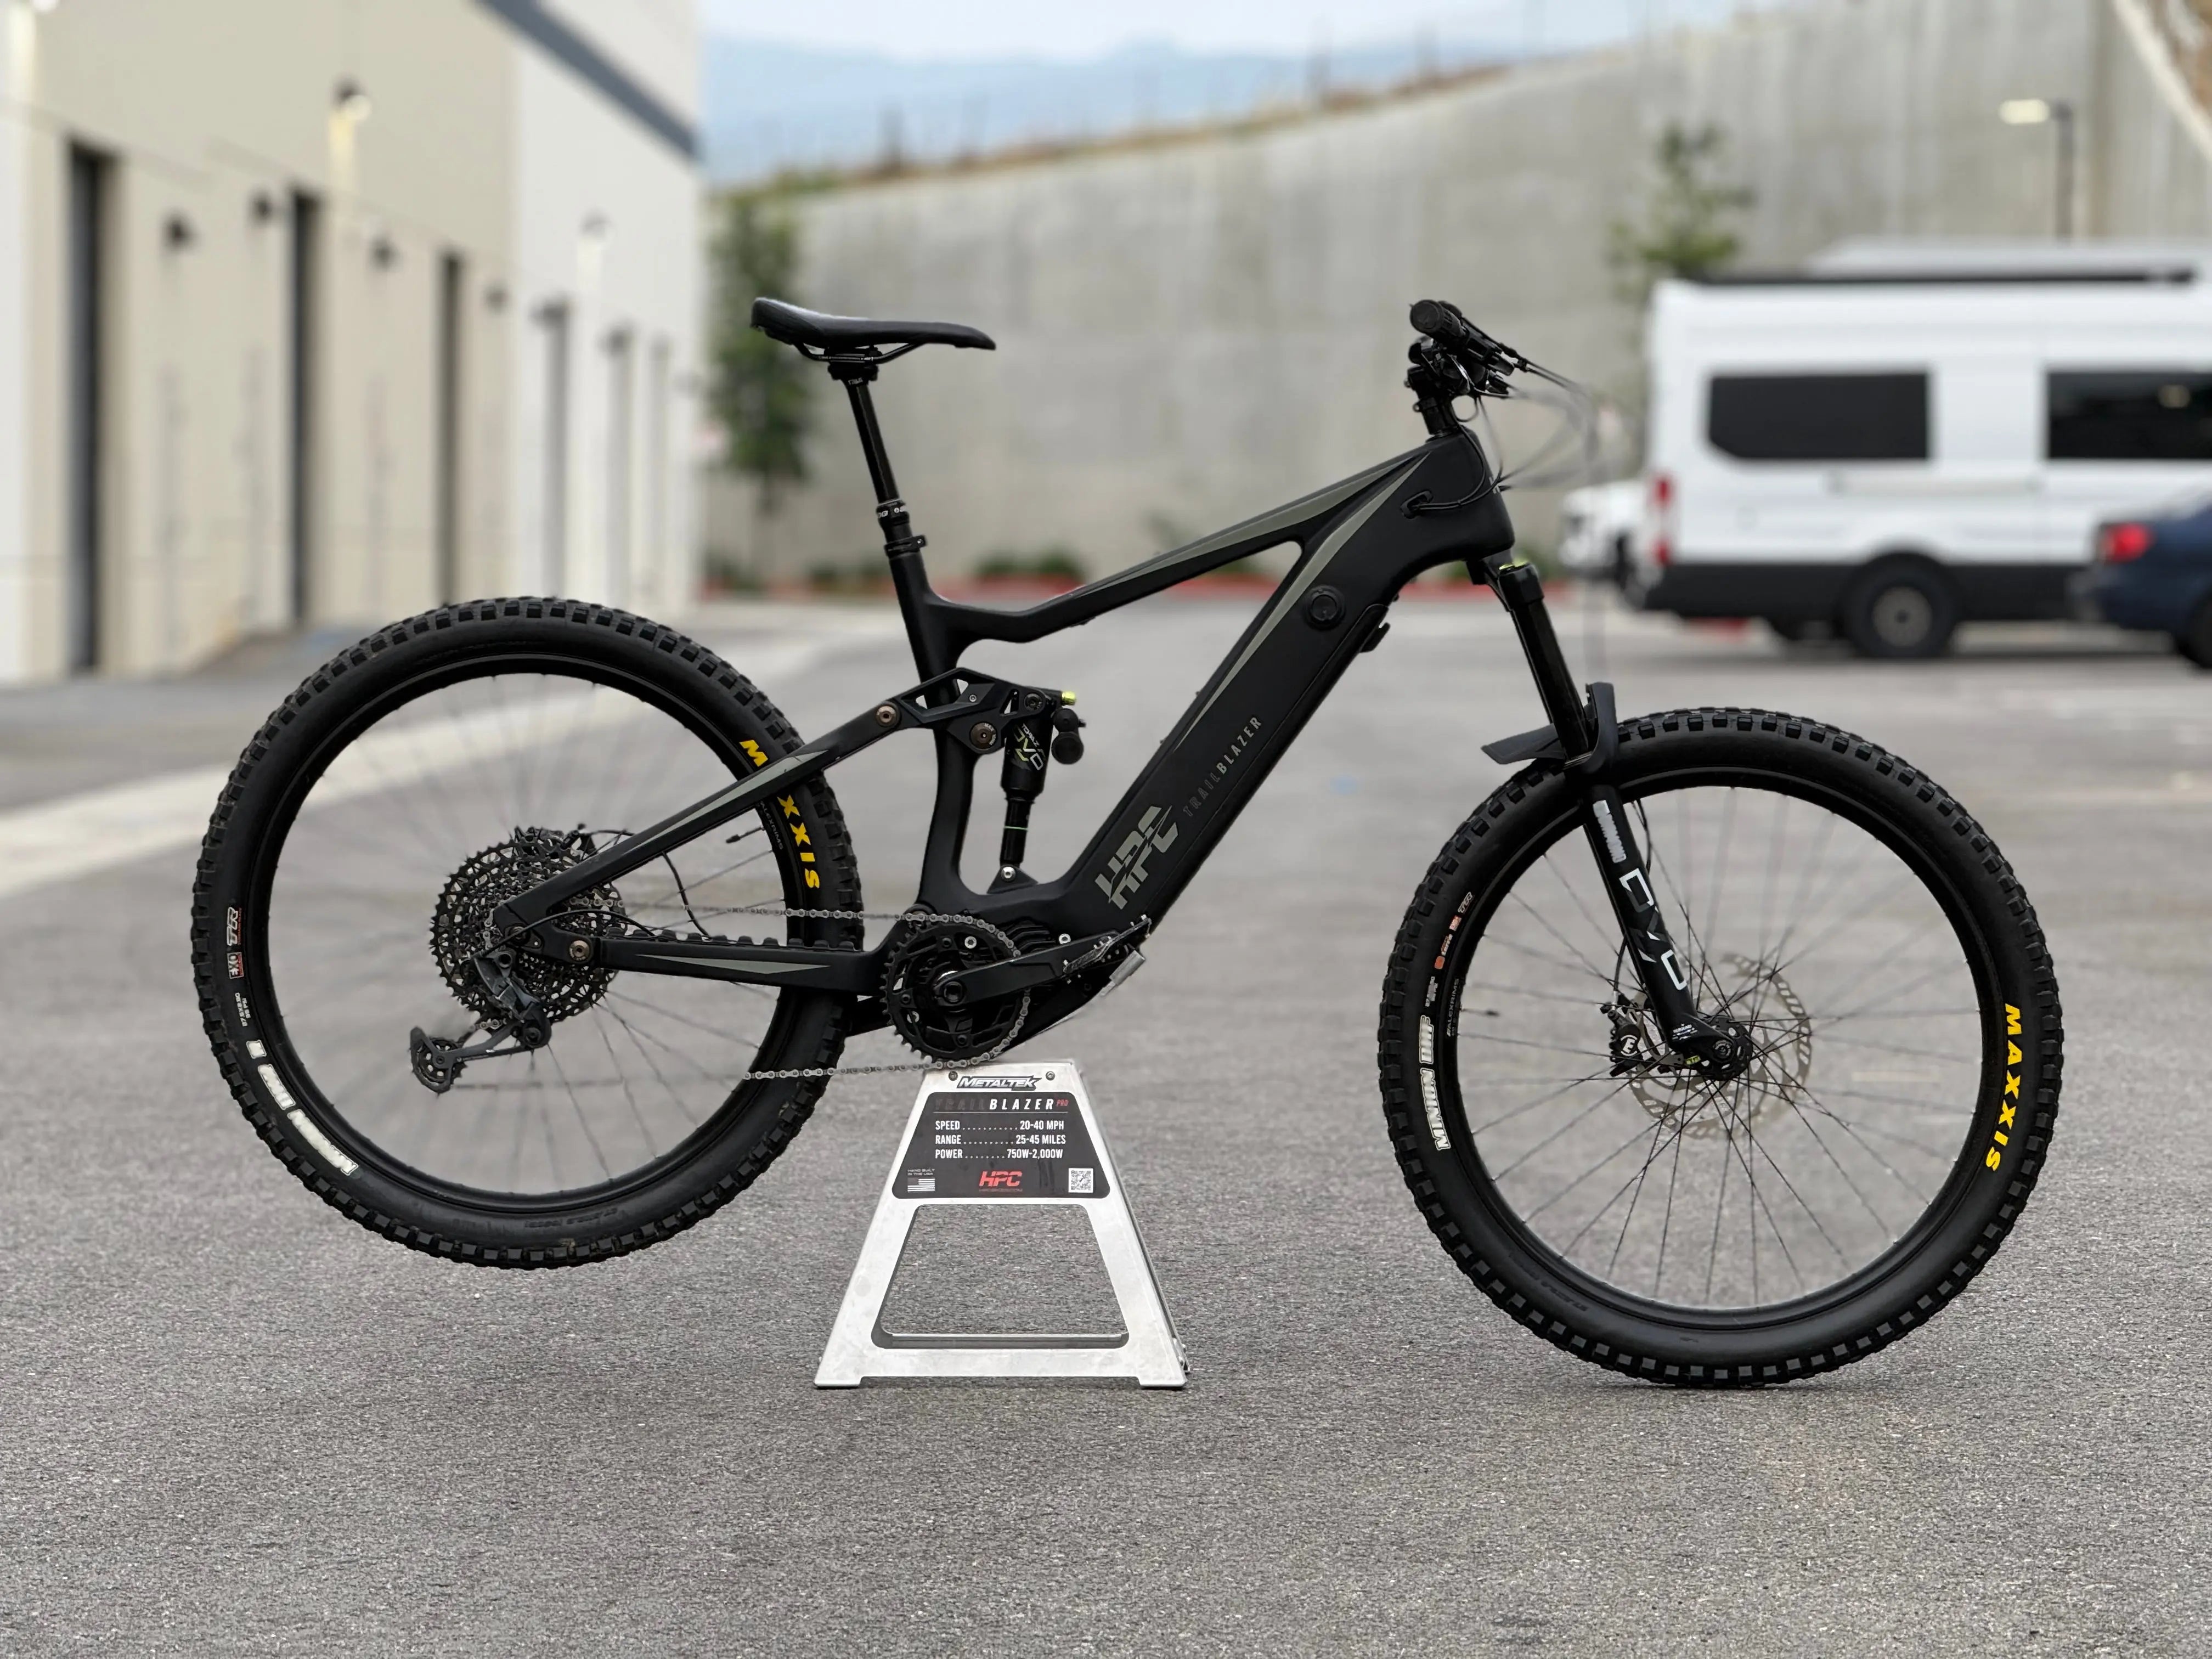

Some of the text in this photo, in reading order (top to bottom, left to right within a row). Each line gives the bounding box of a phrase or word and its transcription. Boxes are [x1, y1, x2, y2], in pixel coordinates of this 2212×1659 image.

[1022, 723, 1040, 747] TOPAZ
[739, 740, 820, 889] MXXIS
[1095, 805, 1180, 910] HPC
[227, 907, 239, 946] TR
[959, 1076, 1040, 1089] METALTEK
[1985, 1003, 2022, 1171] MAXXIS
[935, 1120, 1064, 1130] SPEED 20-40 MPH
[935, 1135, 1066, 1144] RANGE 25-45 MILES
[935, 1149, 1063, 1160] POWER 750W-2,000W
[979, 1171, 1023, 1187] HPC
